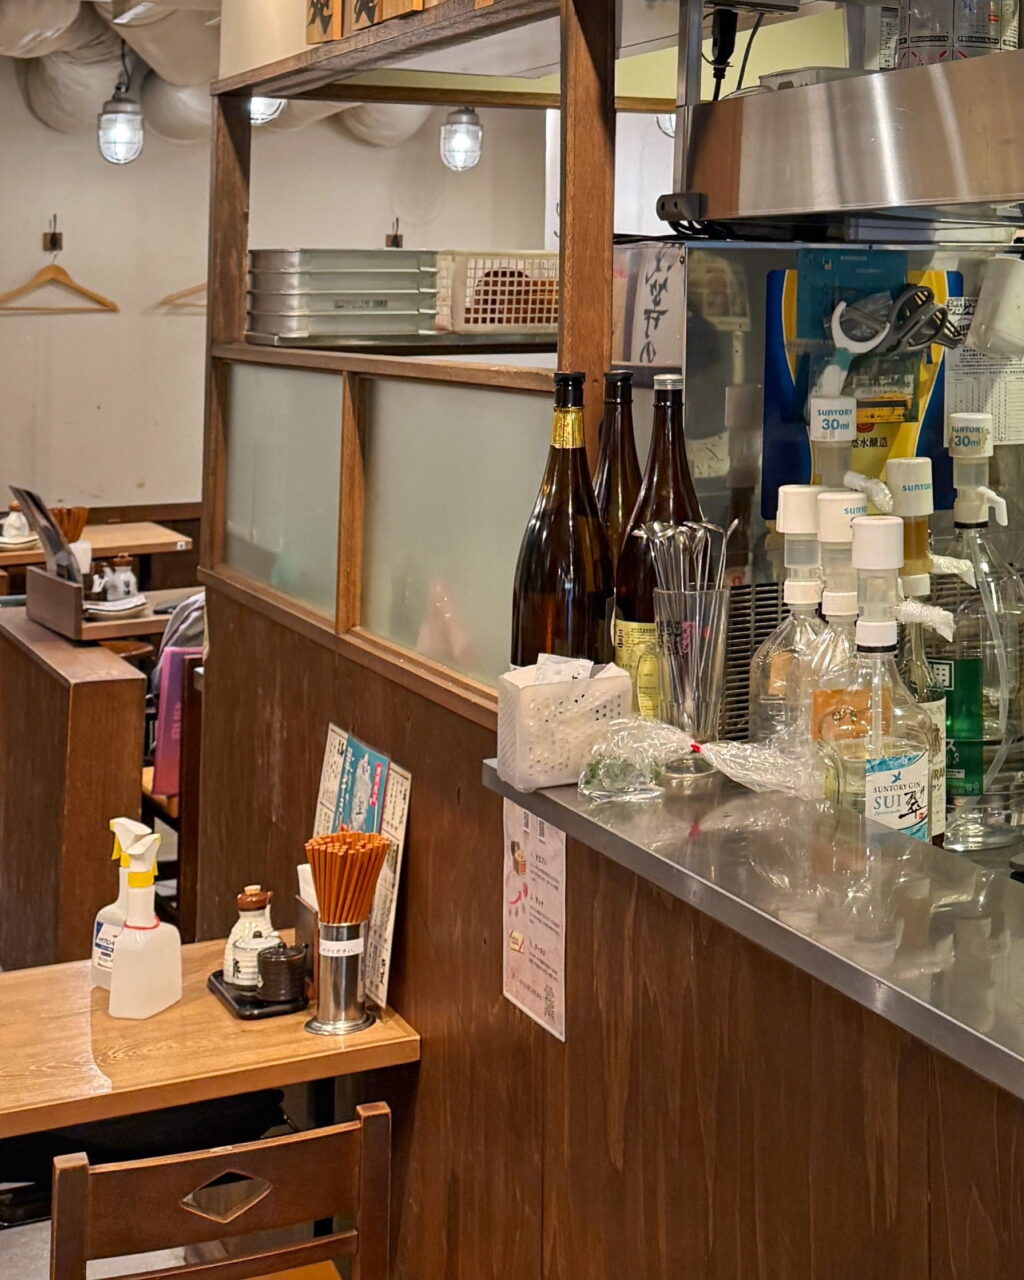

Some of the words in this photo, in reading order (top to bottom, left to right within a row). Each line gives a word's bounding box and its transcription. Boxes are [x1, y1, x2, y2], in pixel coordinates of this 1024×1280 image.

[817, 408, 853, 417] SUNTORY
[951, 426, 985, 435] SUNTORY
[873, 784, 907, 793] SUNTORY
[873, 794, 902, 810] SUI
